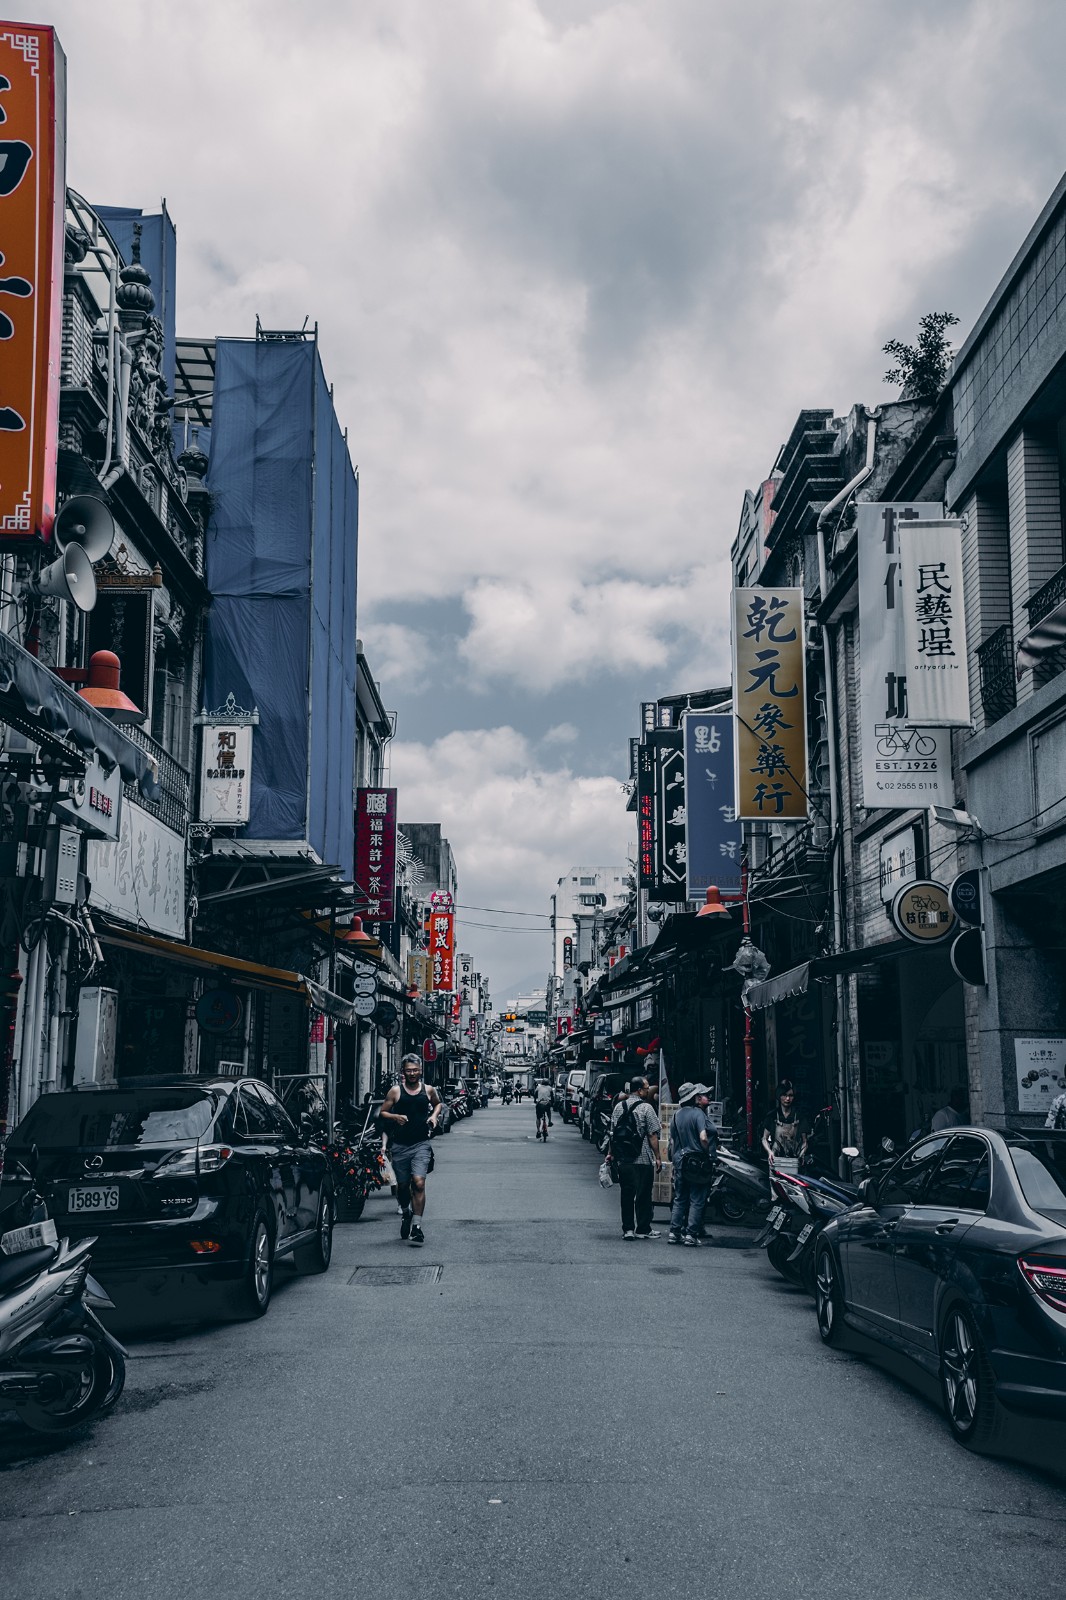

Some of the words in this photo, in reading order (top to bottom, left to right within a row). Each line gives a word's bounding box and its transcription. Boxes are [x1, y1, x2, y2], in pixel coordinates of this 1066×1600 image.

[915, 562, 955, 658] 民藝埕
[914, 663, 959, 671] artyard.tw
[743, 596, 798, 814] 乾元參藥行
[217, 731, 236, 769] 和億
[875, 762, 902, 770] EST.
[907, 761, 937, 770] 1926
[884, 782, 895, 790] 02
[897, 782, 916, 790] 2555
[918, 781, 938, 790] 5118
[369, 818, 383, 862] 福來許
[460, 961, 471, 1001] 百安堂
[594, 1018, 605, 1031] P
[70, 1190, 119, 1210] 1589-YS
